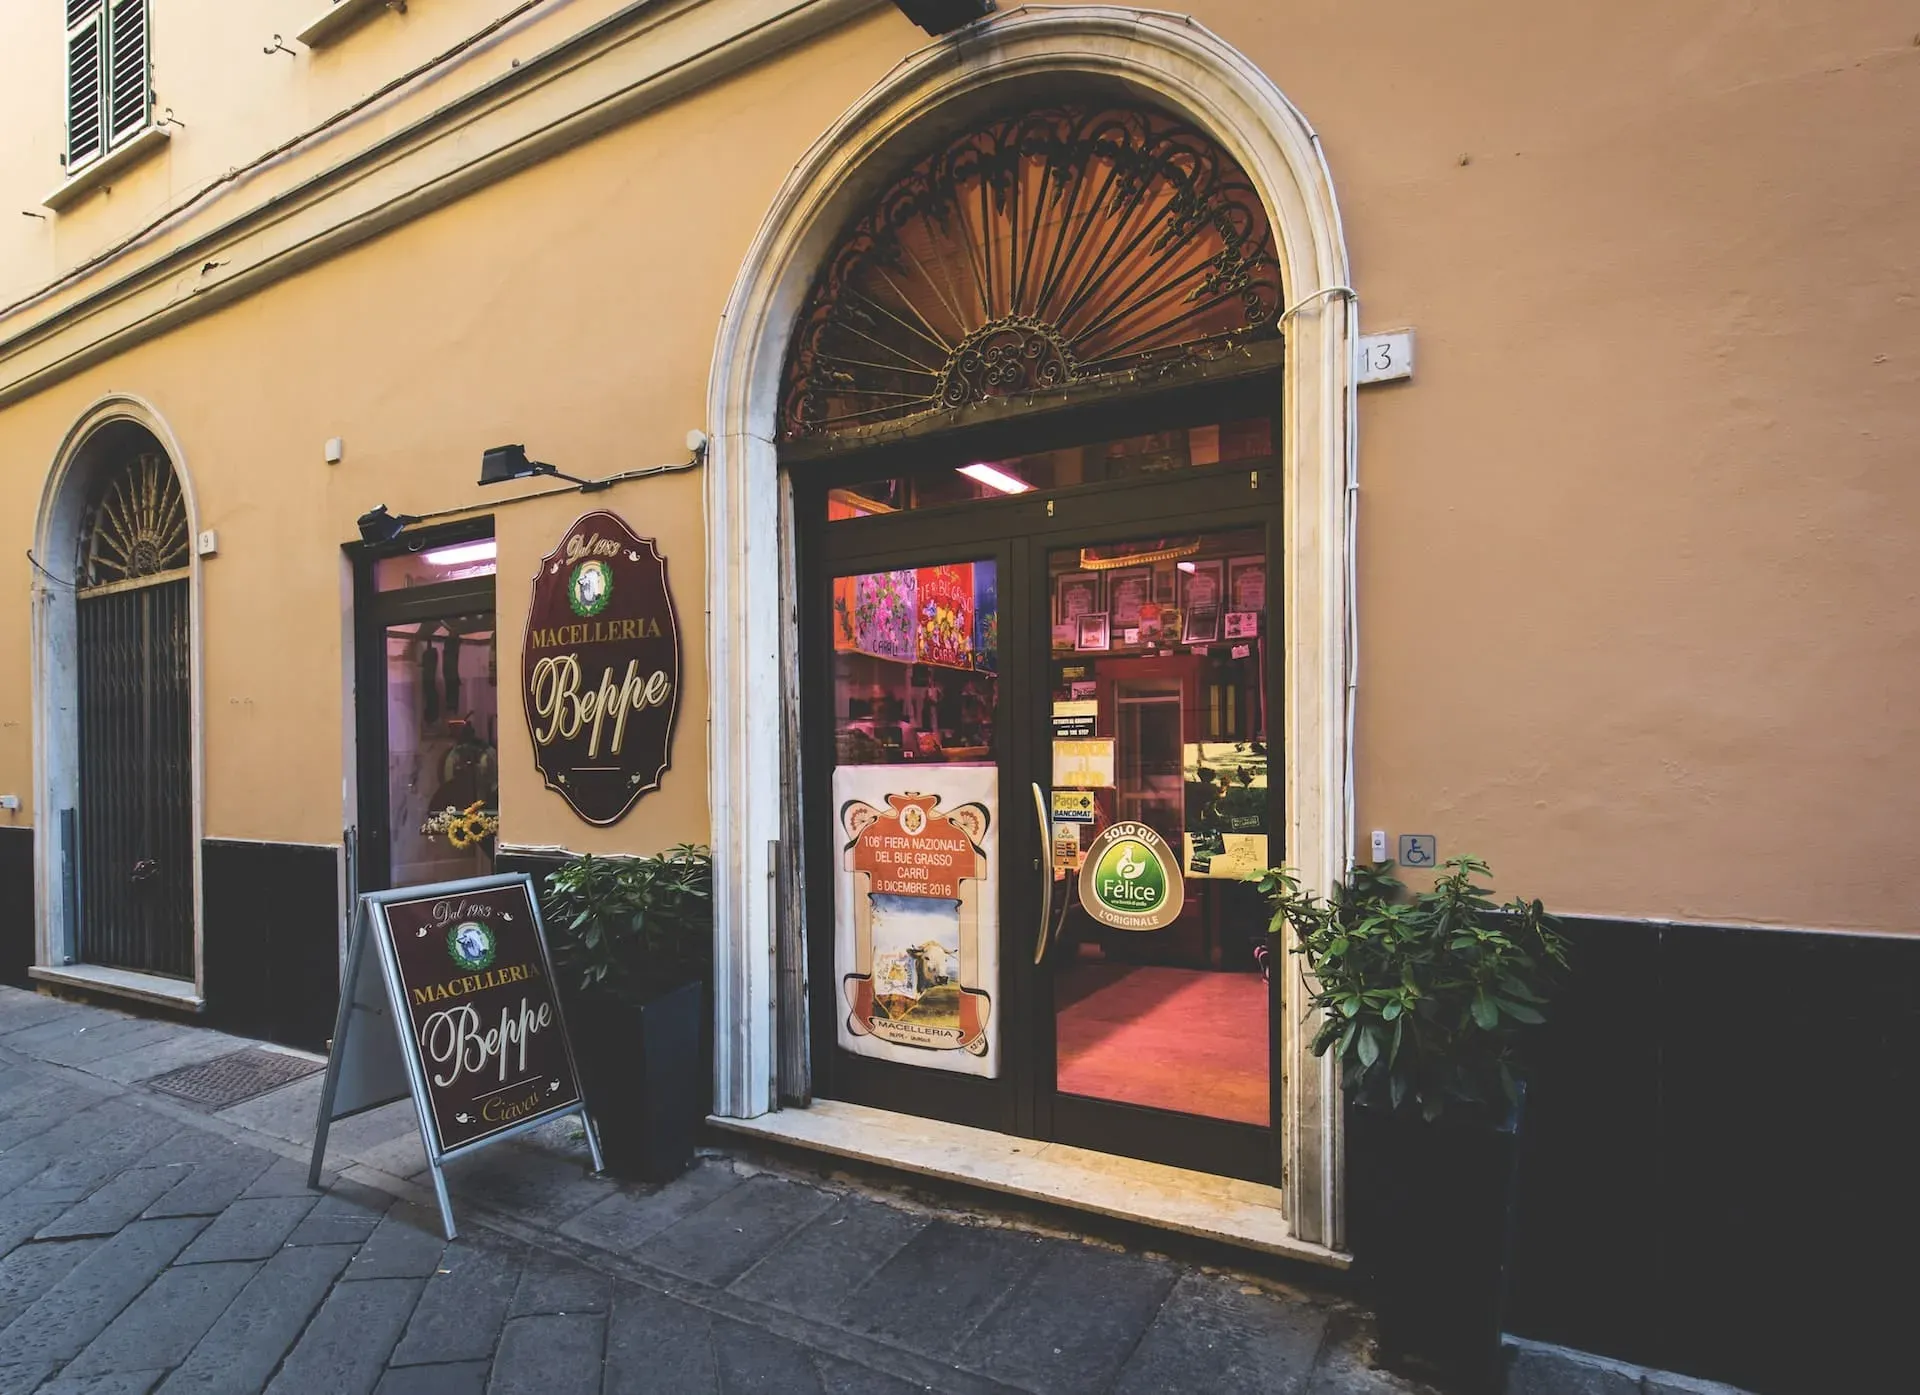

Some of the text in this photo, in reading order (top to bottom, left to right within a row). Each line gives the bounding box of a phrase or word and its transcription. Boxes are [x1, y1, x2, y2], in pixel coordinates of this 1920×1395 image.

[1362, 343, 1392, 373] 13
[566, 533, 622, 566] Dal 1983
[532, 617, 662, 649] MACELLERIA
[531, 652, 672, 759] Beppe
[1054, 795, 1078, 809] Pago
[1055, 810, 1091, 818] BANCOMAT
[884, 836, 910, 849] FIERA
[912, 838, 966, 852] NAZIONALE
[1104, 825, 1160, 846] SOLO QUI
[875, 851, 953, 866] DEL BUE GRASSO
[897, 866, 929, 881] CARRÙ
[877, 880, 952, 896] 8 DICEMBRE 2016
[1104, 880, 1155, 901] Fèlice
[433, 900, 492, 927] Dal 1983
[1098, 910, 1160, 926] L'ORIGINALE
[413, 964, 541, 1006] MACELLERIA
[878, 1020, 953, 1038] MACELLERIA
[422, 997, 553, 1088] Beppe
